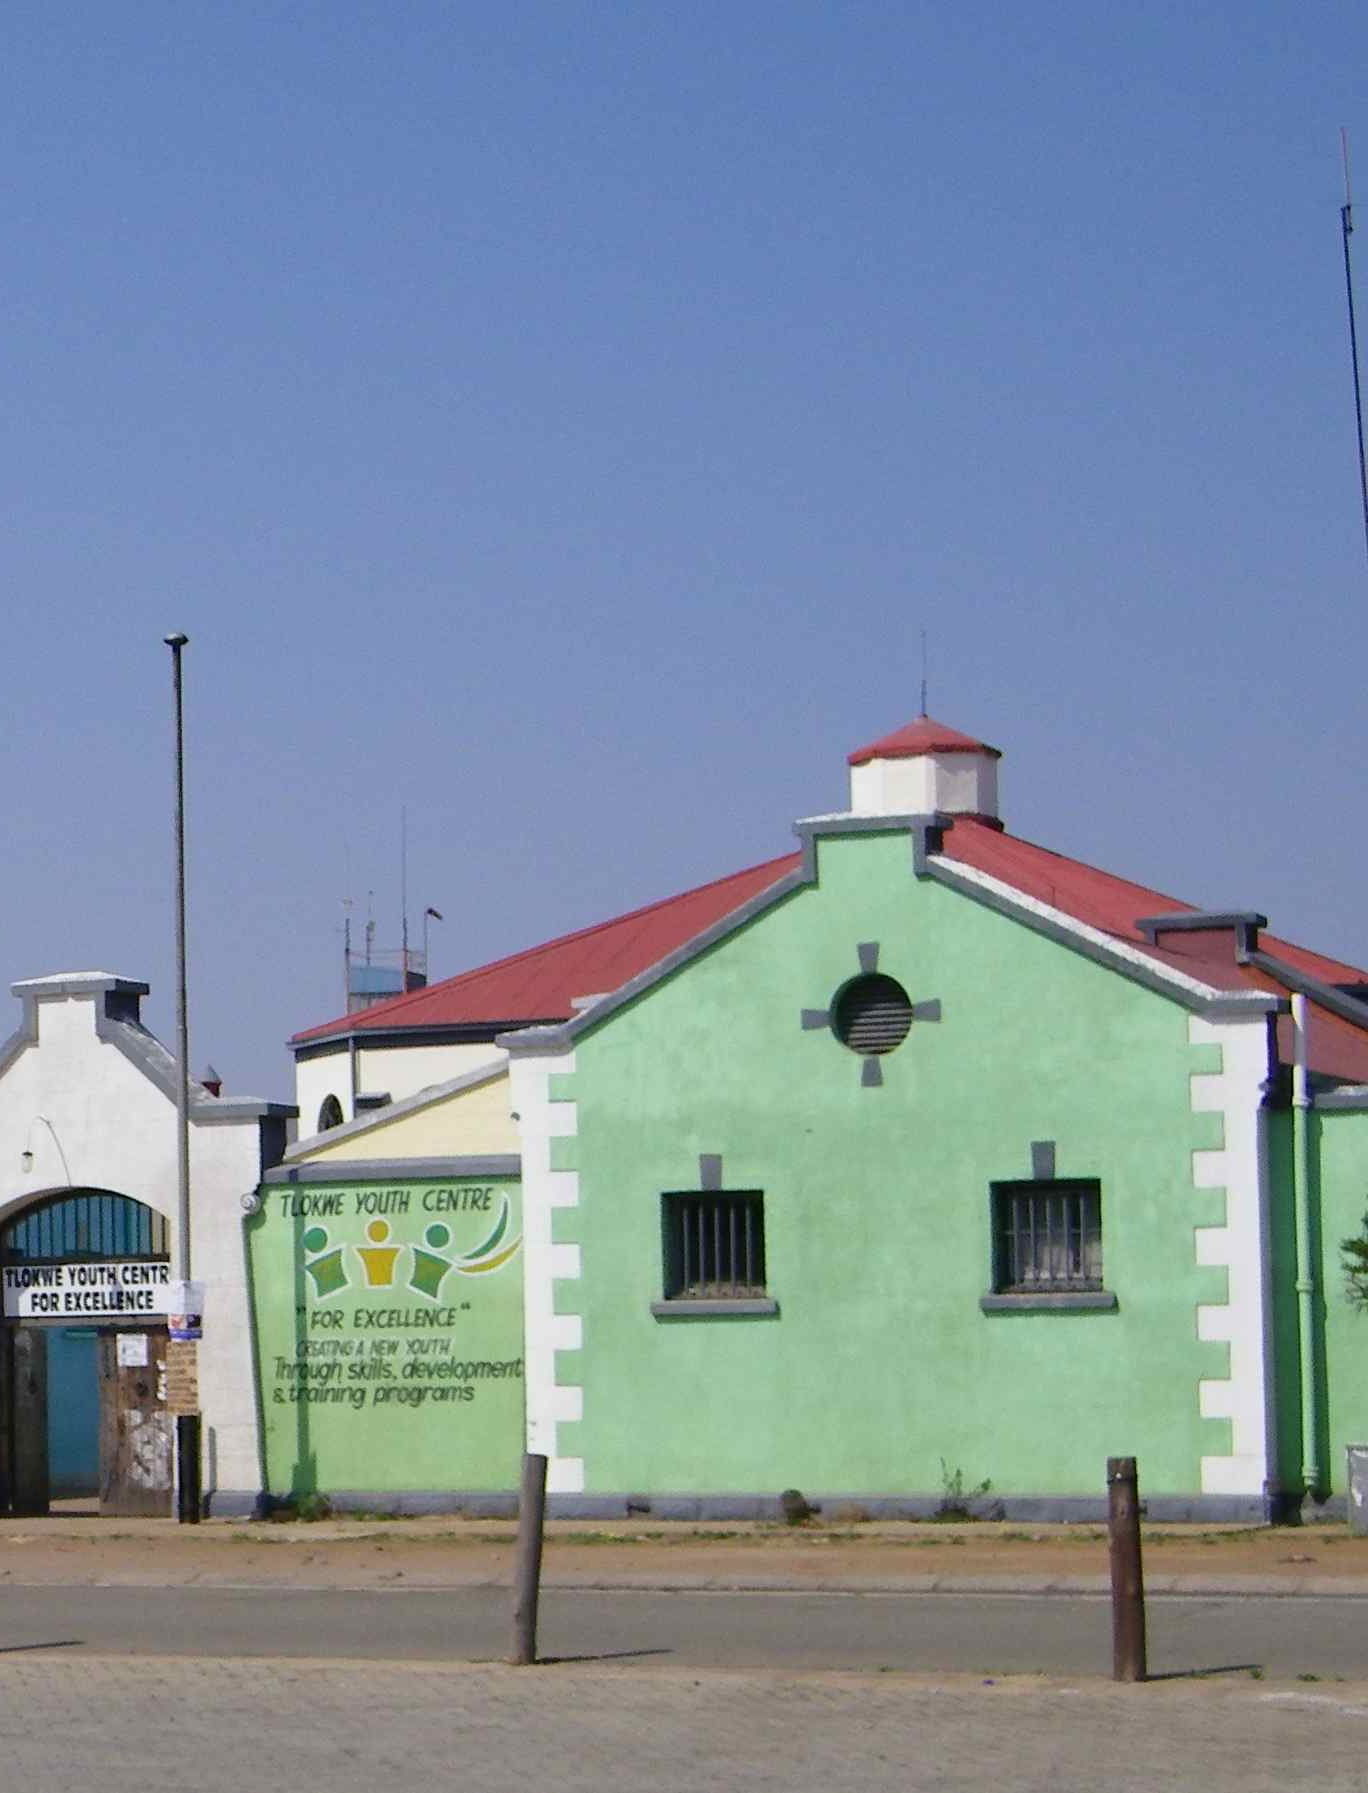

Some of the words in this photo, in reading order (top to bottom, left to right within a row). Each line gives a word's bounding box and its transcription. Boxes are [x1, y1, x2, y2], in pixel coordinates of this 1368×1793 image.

[281, 1193, 346, 1217] TLOKWE
[355, 1191, 411, 1214] YOUTH
[422, 1187, 494, 1212] CENTRE
[5, 1267, 63, 1288] TLOKWE
[68, 1265, 117, 1287] YOUTH
[121, 1265, 169, 1285] CENTR
[31, 1293, 60, 1312] FOR
[65, 1290, 154, 1311] EXCELLENCE
[353, 1340, 364, 1356] A
[371, 1339, 399, 1357] NEW
[407, 1338, 451, 1355] YOUTH
[272, 1356, 343, 1384] Through
[402, 1357, 524, 1382] development
[289, 1386, 366, 1409] training
[373, 1385, 475, 1408] programs
